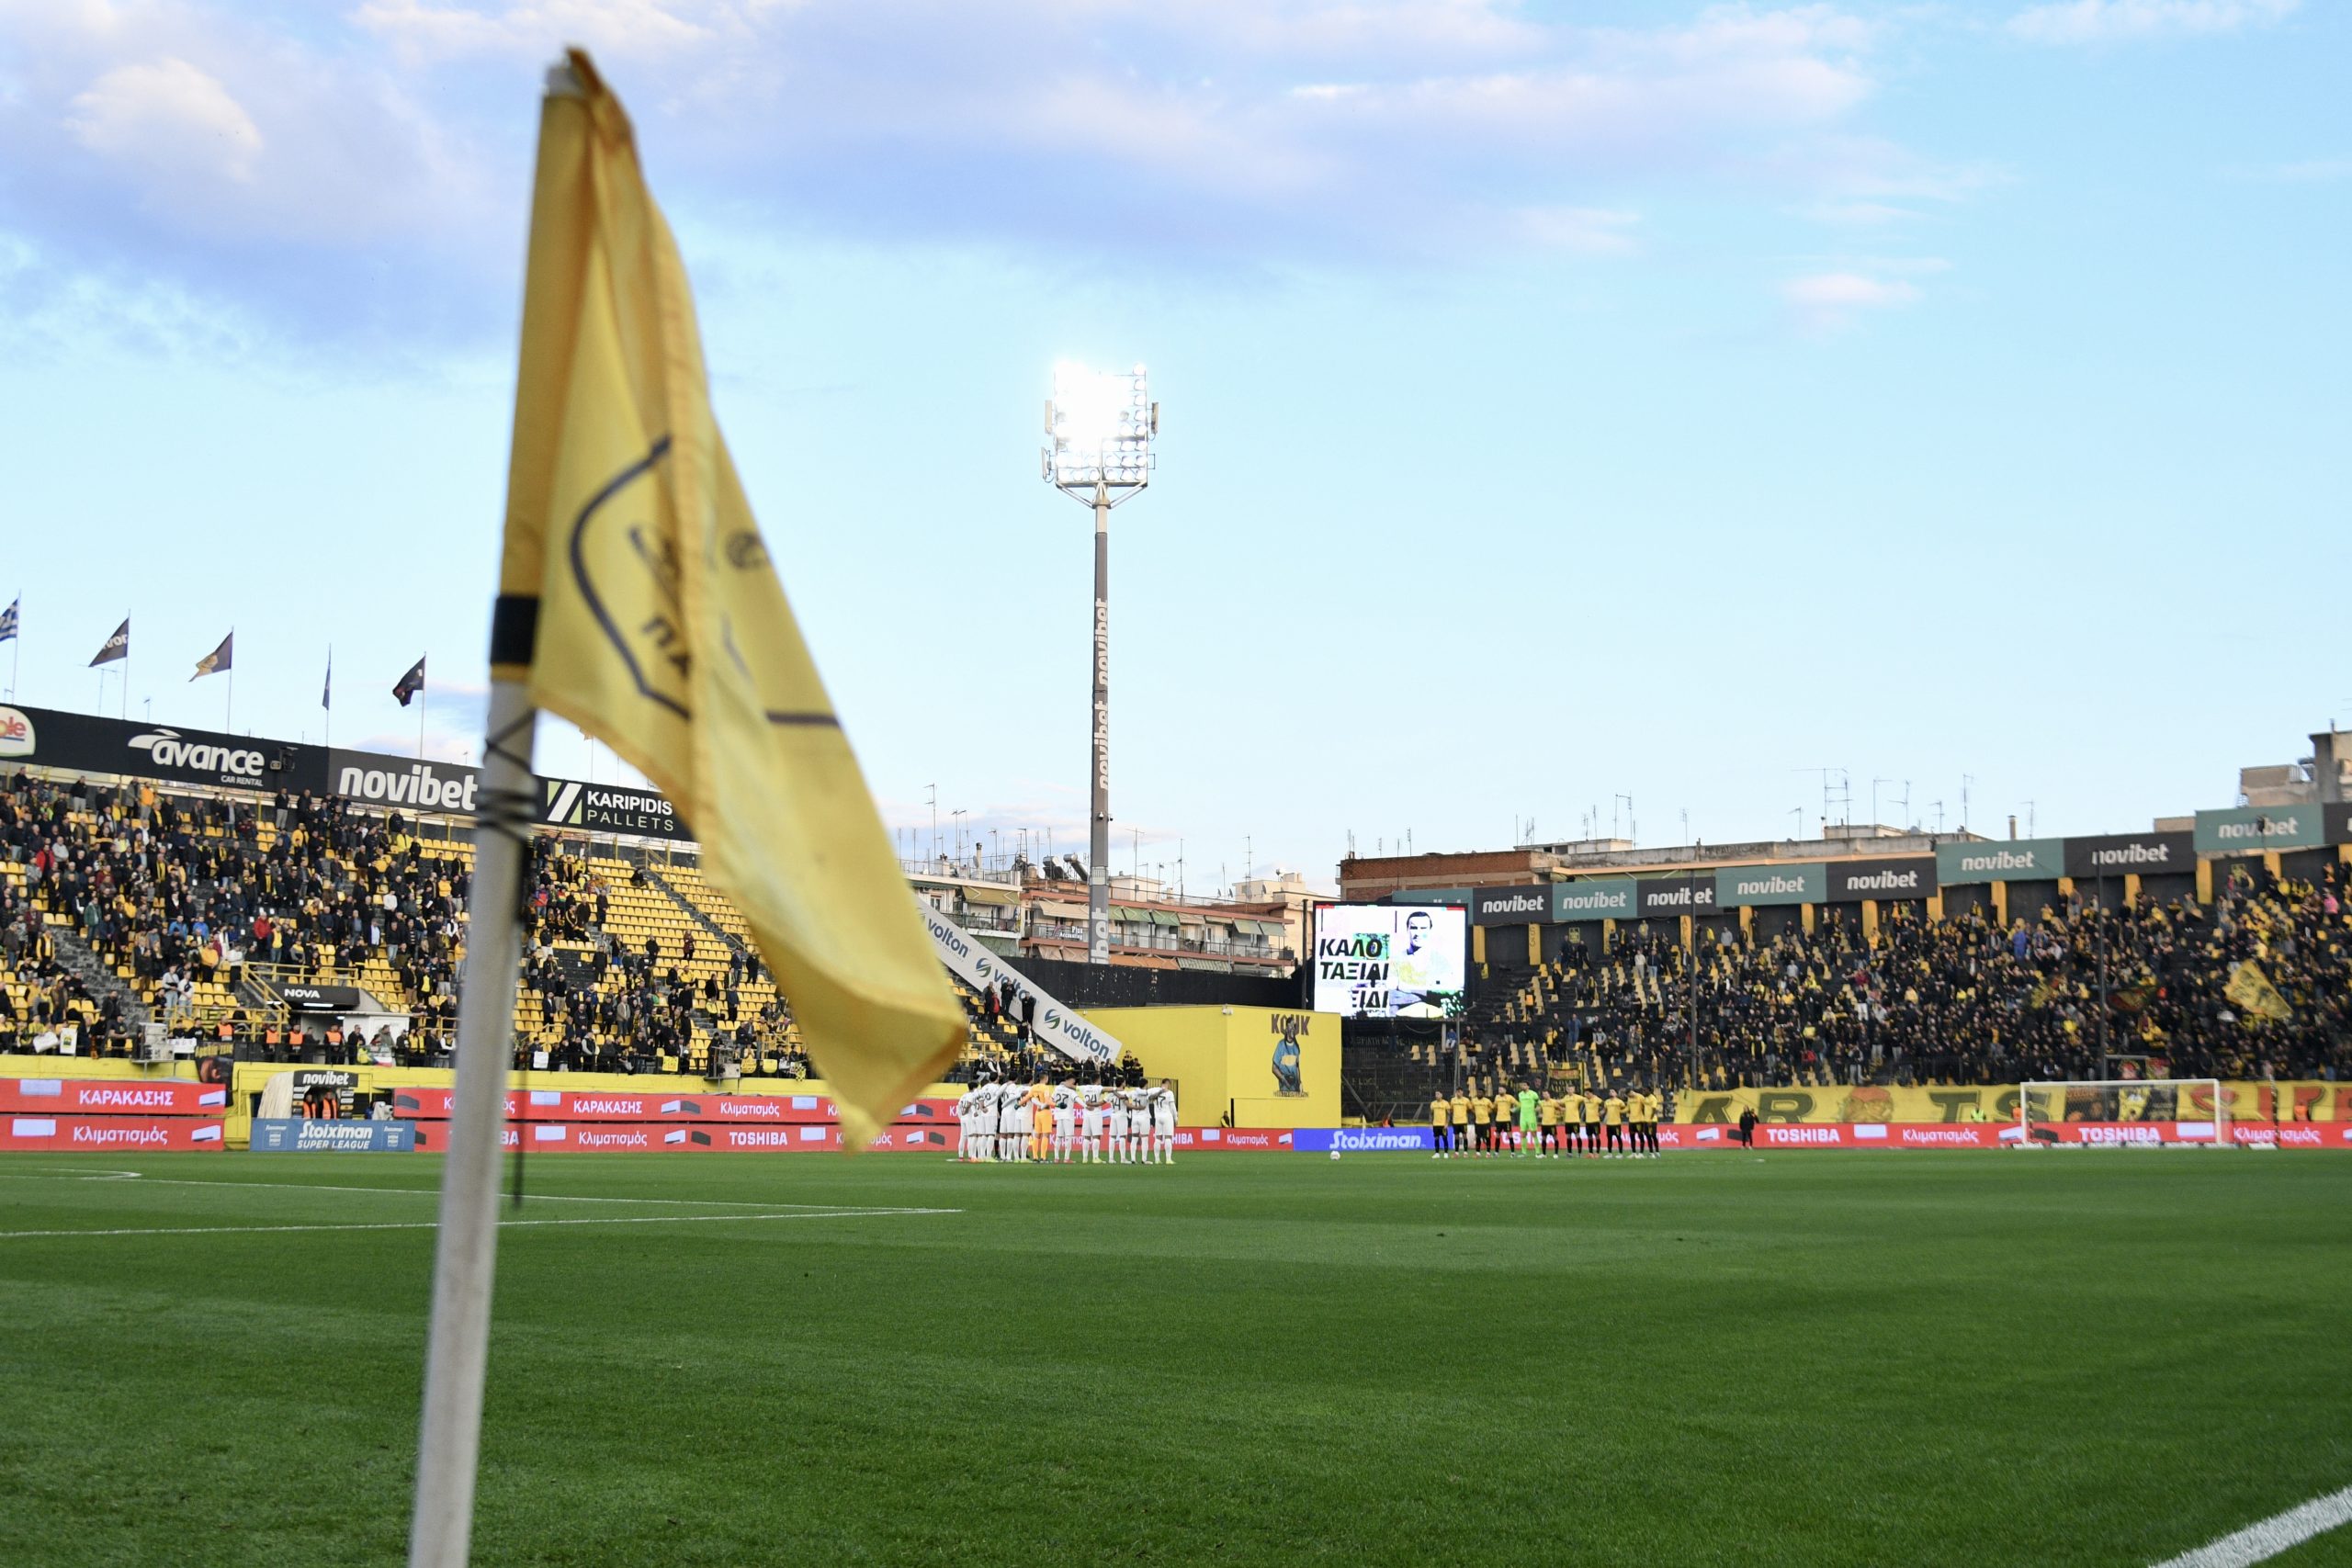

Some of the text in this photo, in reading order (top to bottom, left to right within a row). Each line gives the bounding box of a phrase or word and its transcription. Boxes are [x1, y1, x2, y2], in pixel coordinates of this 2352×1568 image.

[0, 716, 27, 738] ole
[151, 739, 265, 776] avance
[220, 774, 264, 787] CAR RENTAL
[339, 764, 479, 811] novibet
[587, 790, 673, 816] KARIPIDIS
[587, 810, 674, 832] PALLETS
[1962, 850, 2034, 871] novibet
[2092, 842, 2169, 865] novibet
[1737, 875, 1805, 896] novibet
[1847, 870, 1918, 890] novibet
[1482, 895, 1544, 913] novibet
[1563, 891, 1627, 909] novibet
[928, 919, 969, 958] volton
[284, 988, 321, 998] NOVA
[1063, 1020, 1110, 1059] volton
[302, 1070, 350, 1086] novibet
[79, 1089, 174, 1106] ΚΑΡΑΚΑΣΗΣ
[573, 1100, 642, 1113] ΚΑΡΑΚΑΣΗΣ
[720, 1102, 780, 1117] Κλιματισμός
[74, 1125, 168, 1145] Κλιματισμός
[299, 1121, 373, 1139] Stoiximan
[578, 1131, 648, 1146] Κλιματισμός
[729, 1132, 788, 1145] TOSHIBA
[1767, 1128, 1840, 1144] TOSHIBA
[1902, 1127, 1979, 1145] Κλιματισμός
[2078, 1127, 2160, 1143] TOSHIBA
[297, 1139, 371, 1149] SUPER LEAGUE
[1227, 1134, 1269, 1145] Κλιματισμός
[1329, 1131, 1421, 1149] Stoiximan
